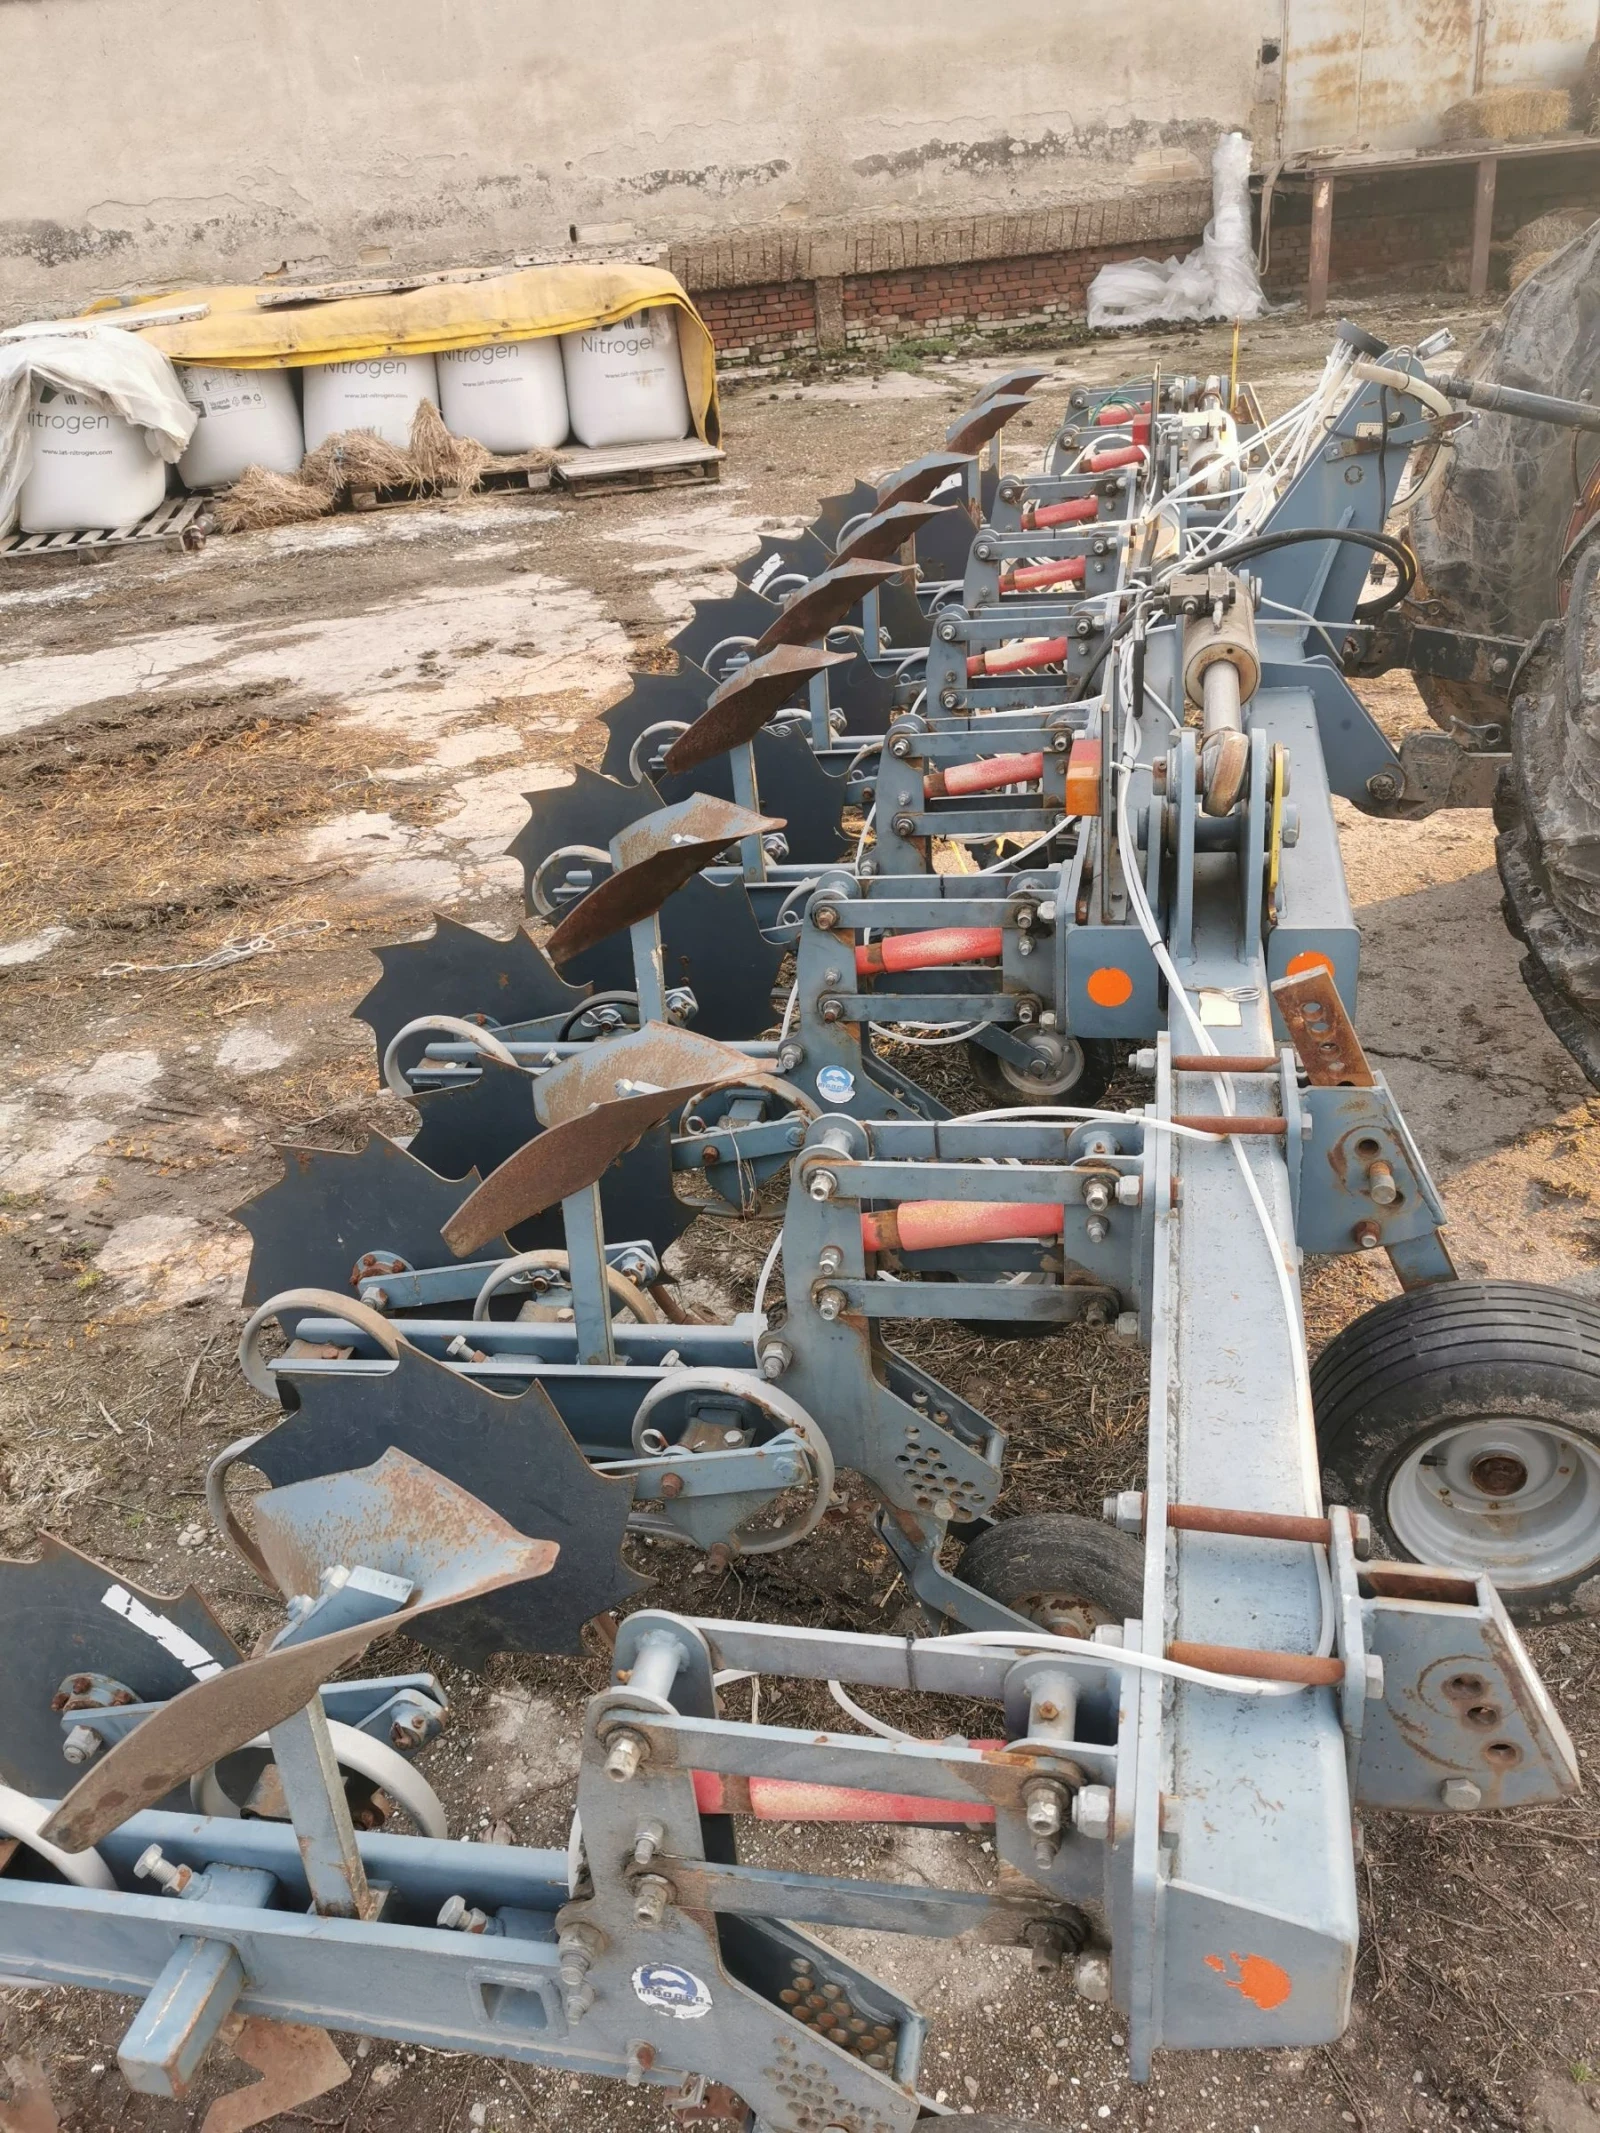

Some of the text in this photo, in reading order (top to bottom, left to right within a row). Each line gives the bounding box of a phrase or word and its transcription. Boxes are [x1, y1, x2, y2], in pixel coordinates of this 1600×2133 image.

[442, 344, 519, 365] Nitrogen
[580, 335, 655, 356] Nitroge
[323, 360, 407, 379] Nitrogen
[42, 449, 113, 457] www.lat-nitrogen.com
